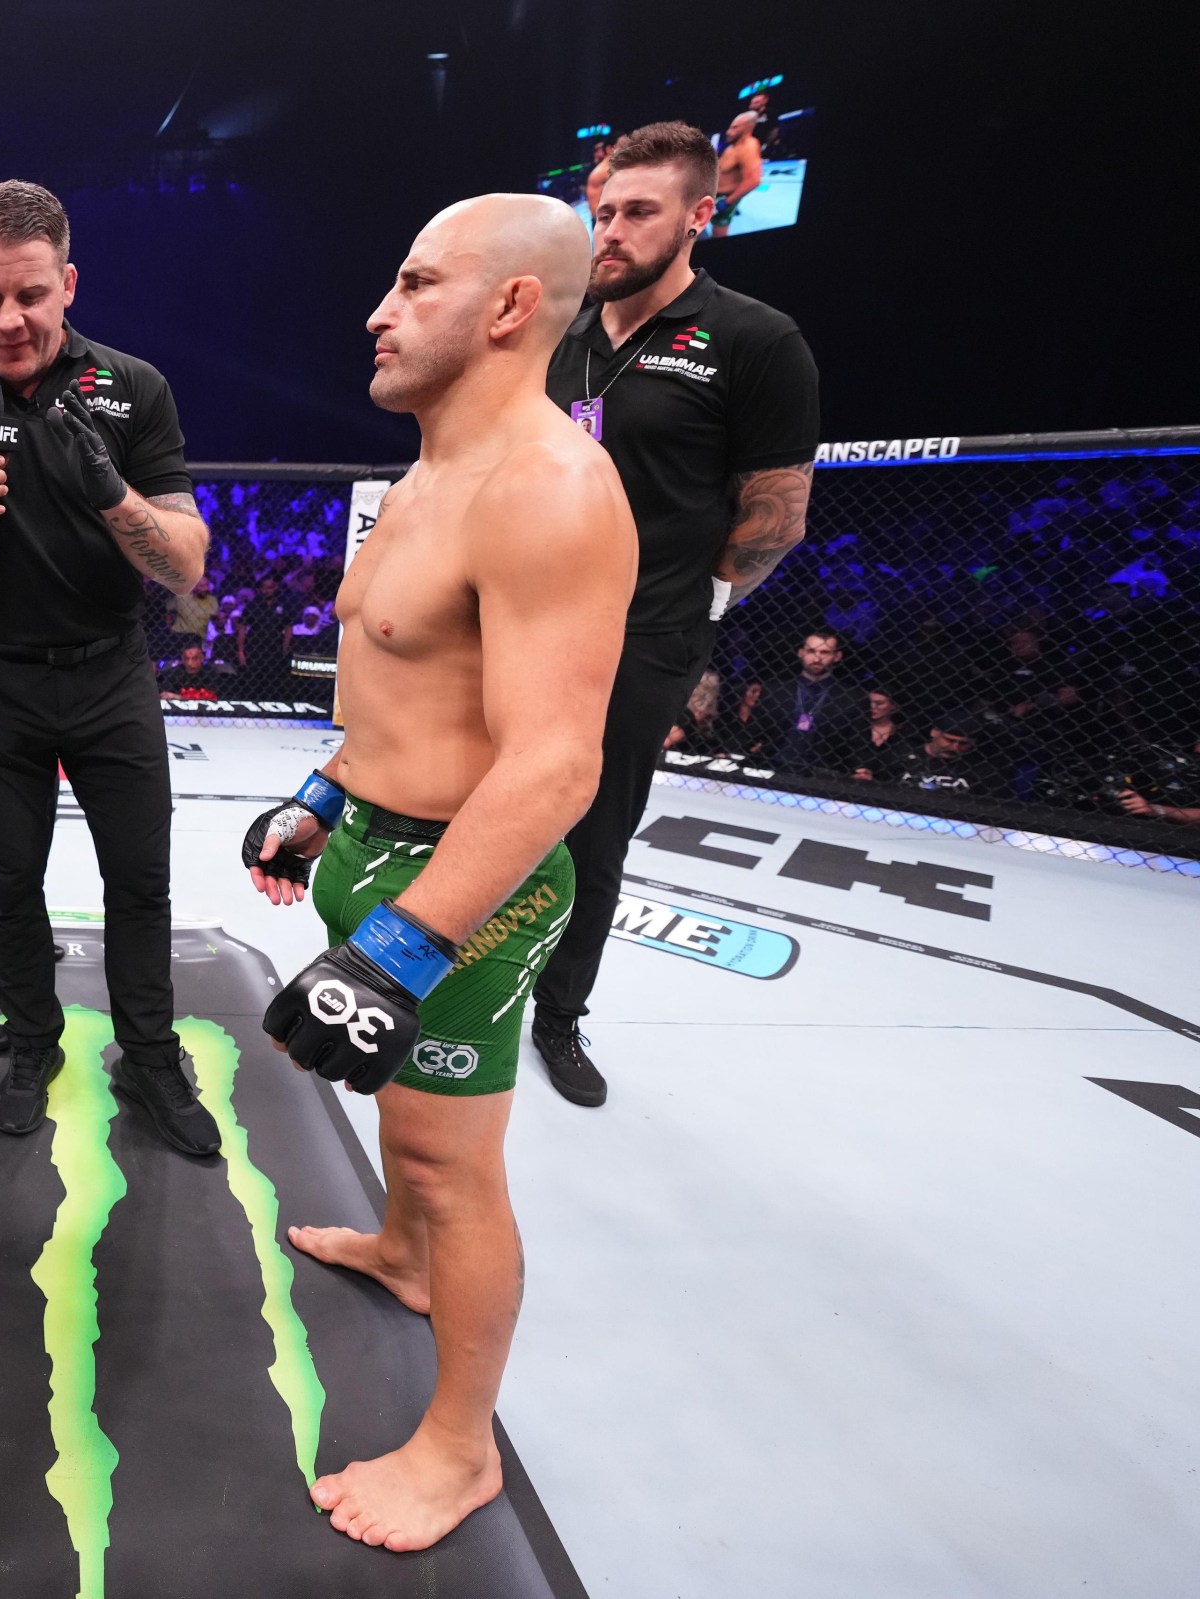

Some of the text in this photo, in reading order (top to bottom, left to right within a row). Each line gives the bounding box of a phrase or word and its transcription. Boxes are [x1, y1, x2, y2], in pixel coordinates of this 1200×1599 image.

[639, 354, 717, 376] UAEMMAF
[674, 367, 685, 375] ARTS
[684, 370, 711, 383] FEDERATION
[55, 396, 132, 413] UMMAF
[814, 436, 960, 463] ANSCAPED
[318, 991, 346, 1013] UFC
[441, 1041, 458, 1050] UFC
[421, 1045, 476, 1075] 30
[434, 1070, 455, 1078] YEARS
